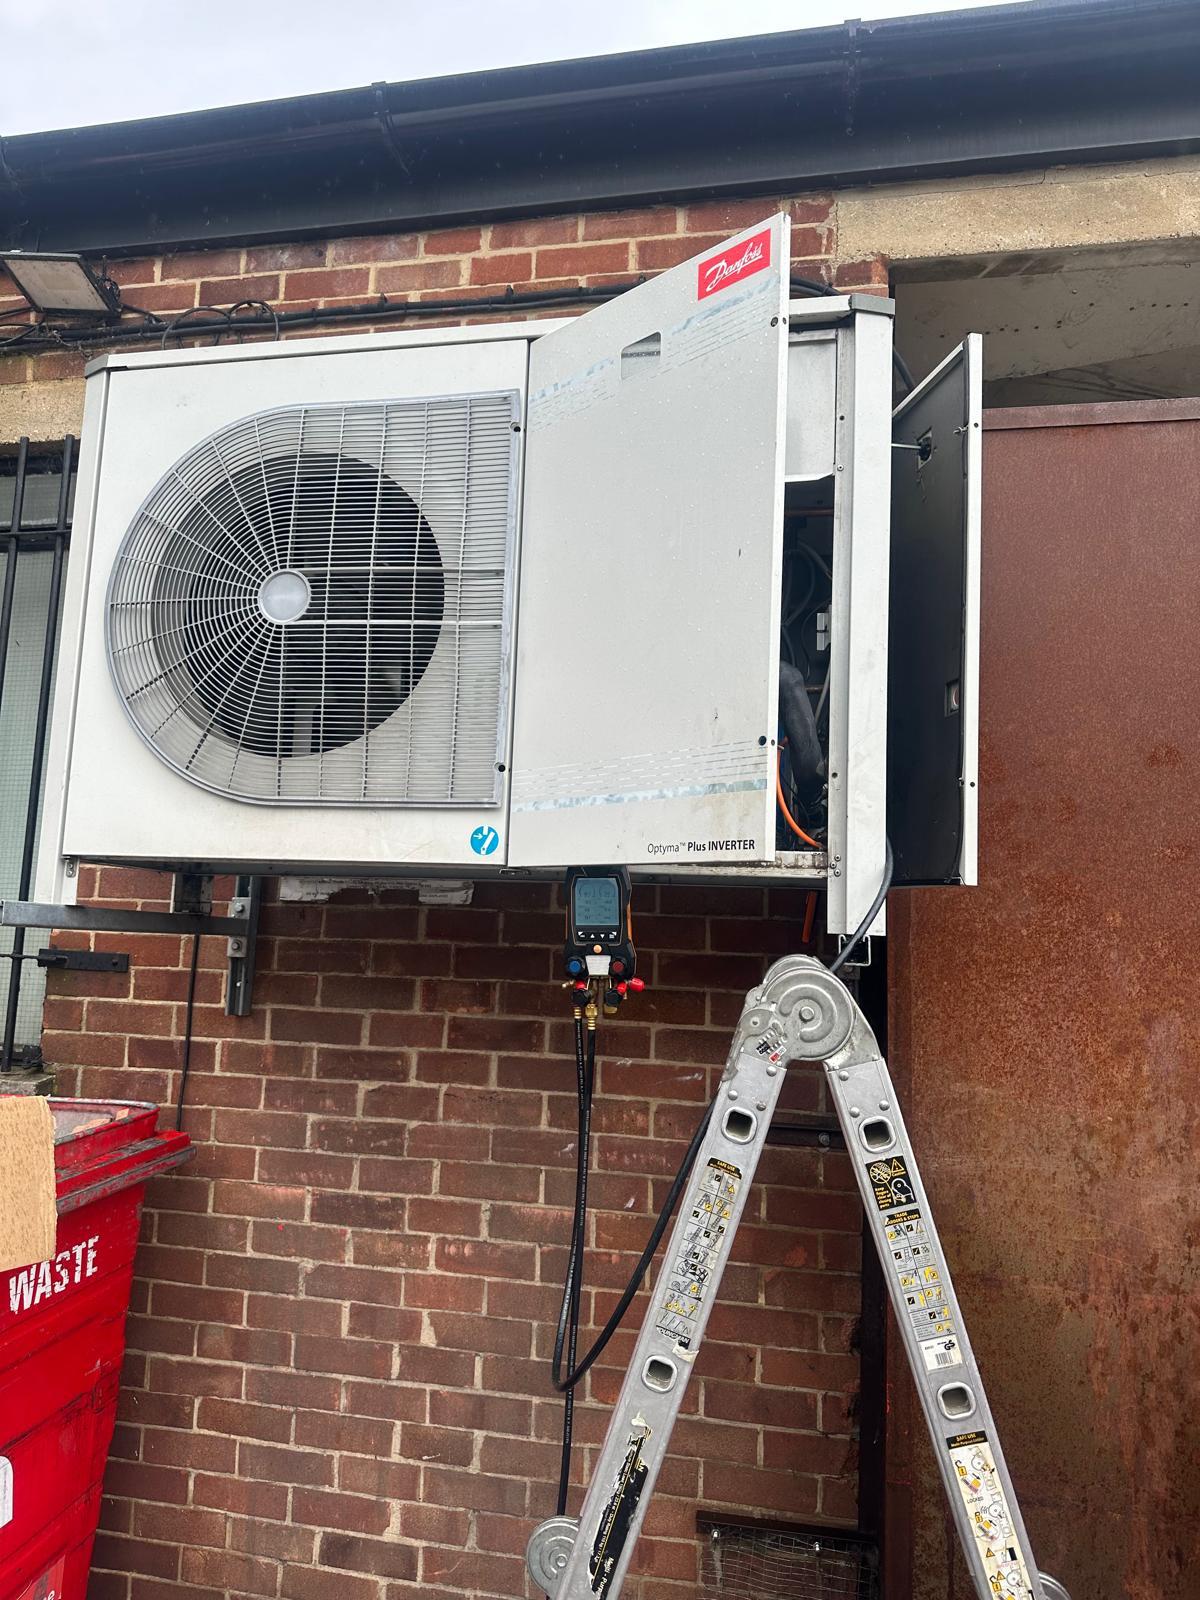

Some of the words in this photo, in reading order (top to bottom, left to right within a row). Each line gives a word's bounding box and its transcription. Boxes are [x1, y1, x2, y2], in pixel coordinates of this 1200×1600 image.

[704, 242, 764, 292] Danfoss
[687, 842, 706, 852] Plus
[708, 839, 755, 851] INVERTER
[9, 1235, 99, 1314] WASTE
